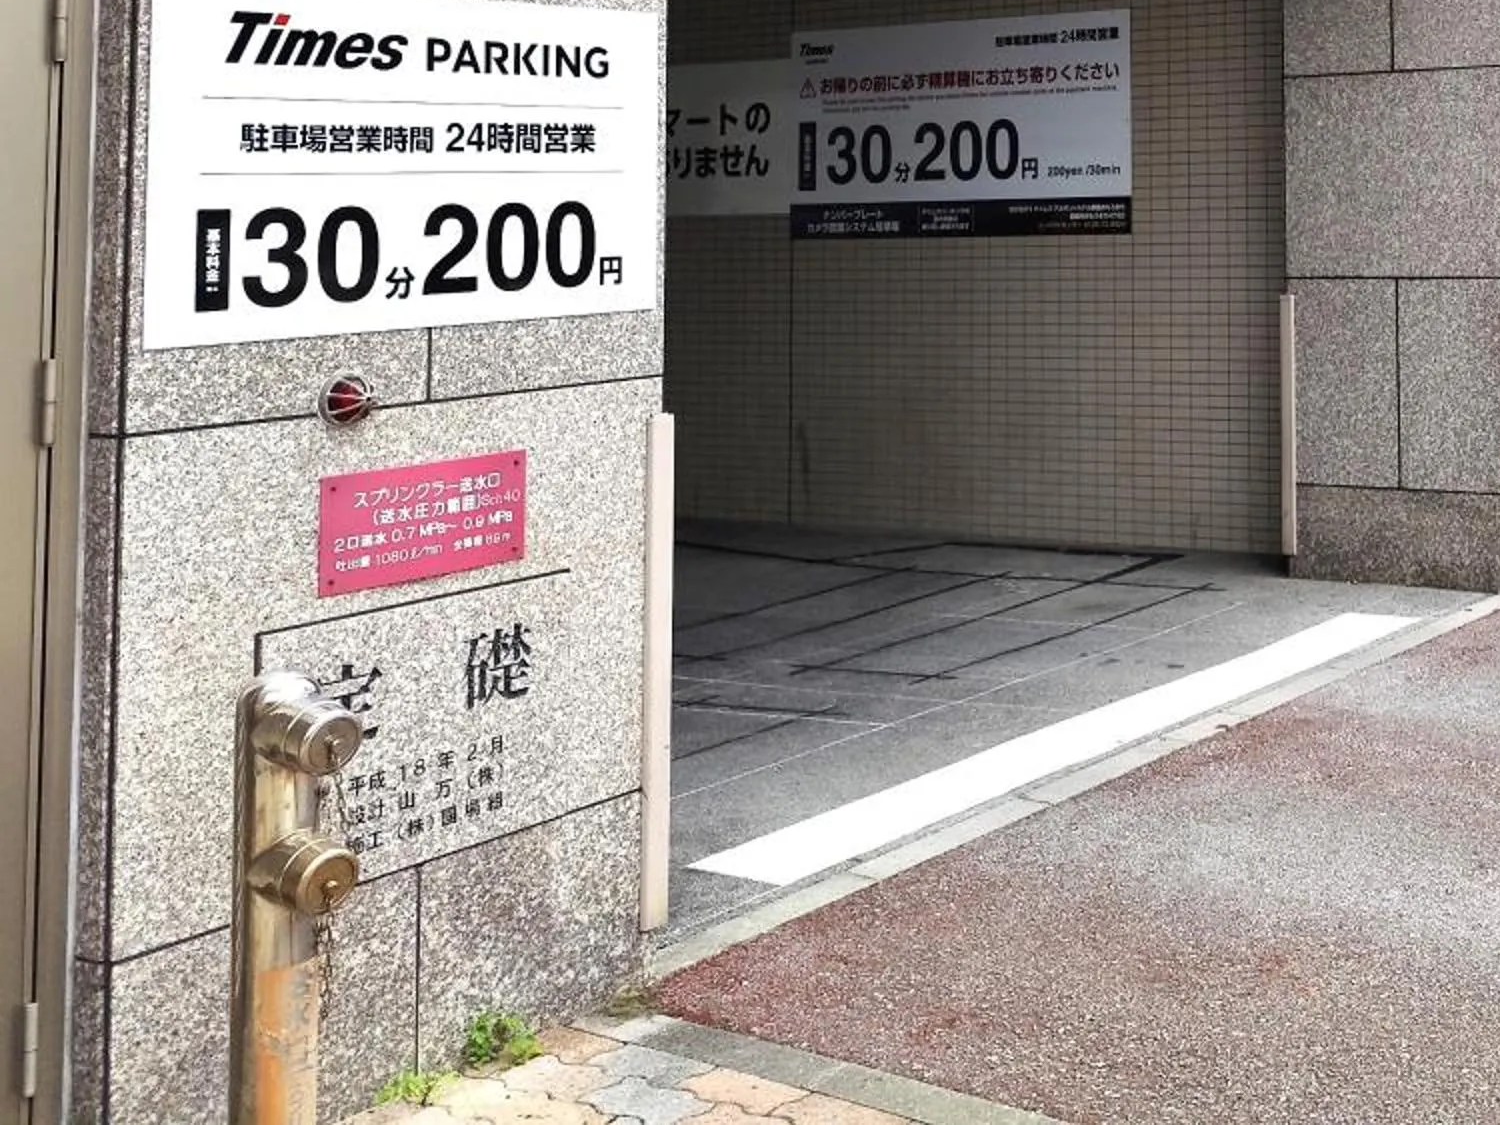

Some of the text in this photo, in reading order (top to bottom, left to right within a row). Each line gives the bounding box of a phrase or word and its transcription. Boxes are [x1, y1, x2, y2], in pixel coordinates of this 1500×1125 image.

[225, 10, 611, 79] Times PARKING
[240, 122, 597, 154] 駐車場営業時間 24時間営業
[666, 144, 769, 179] りません
